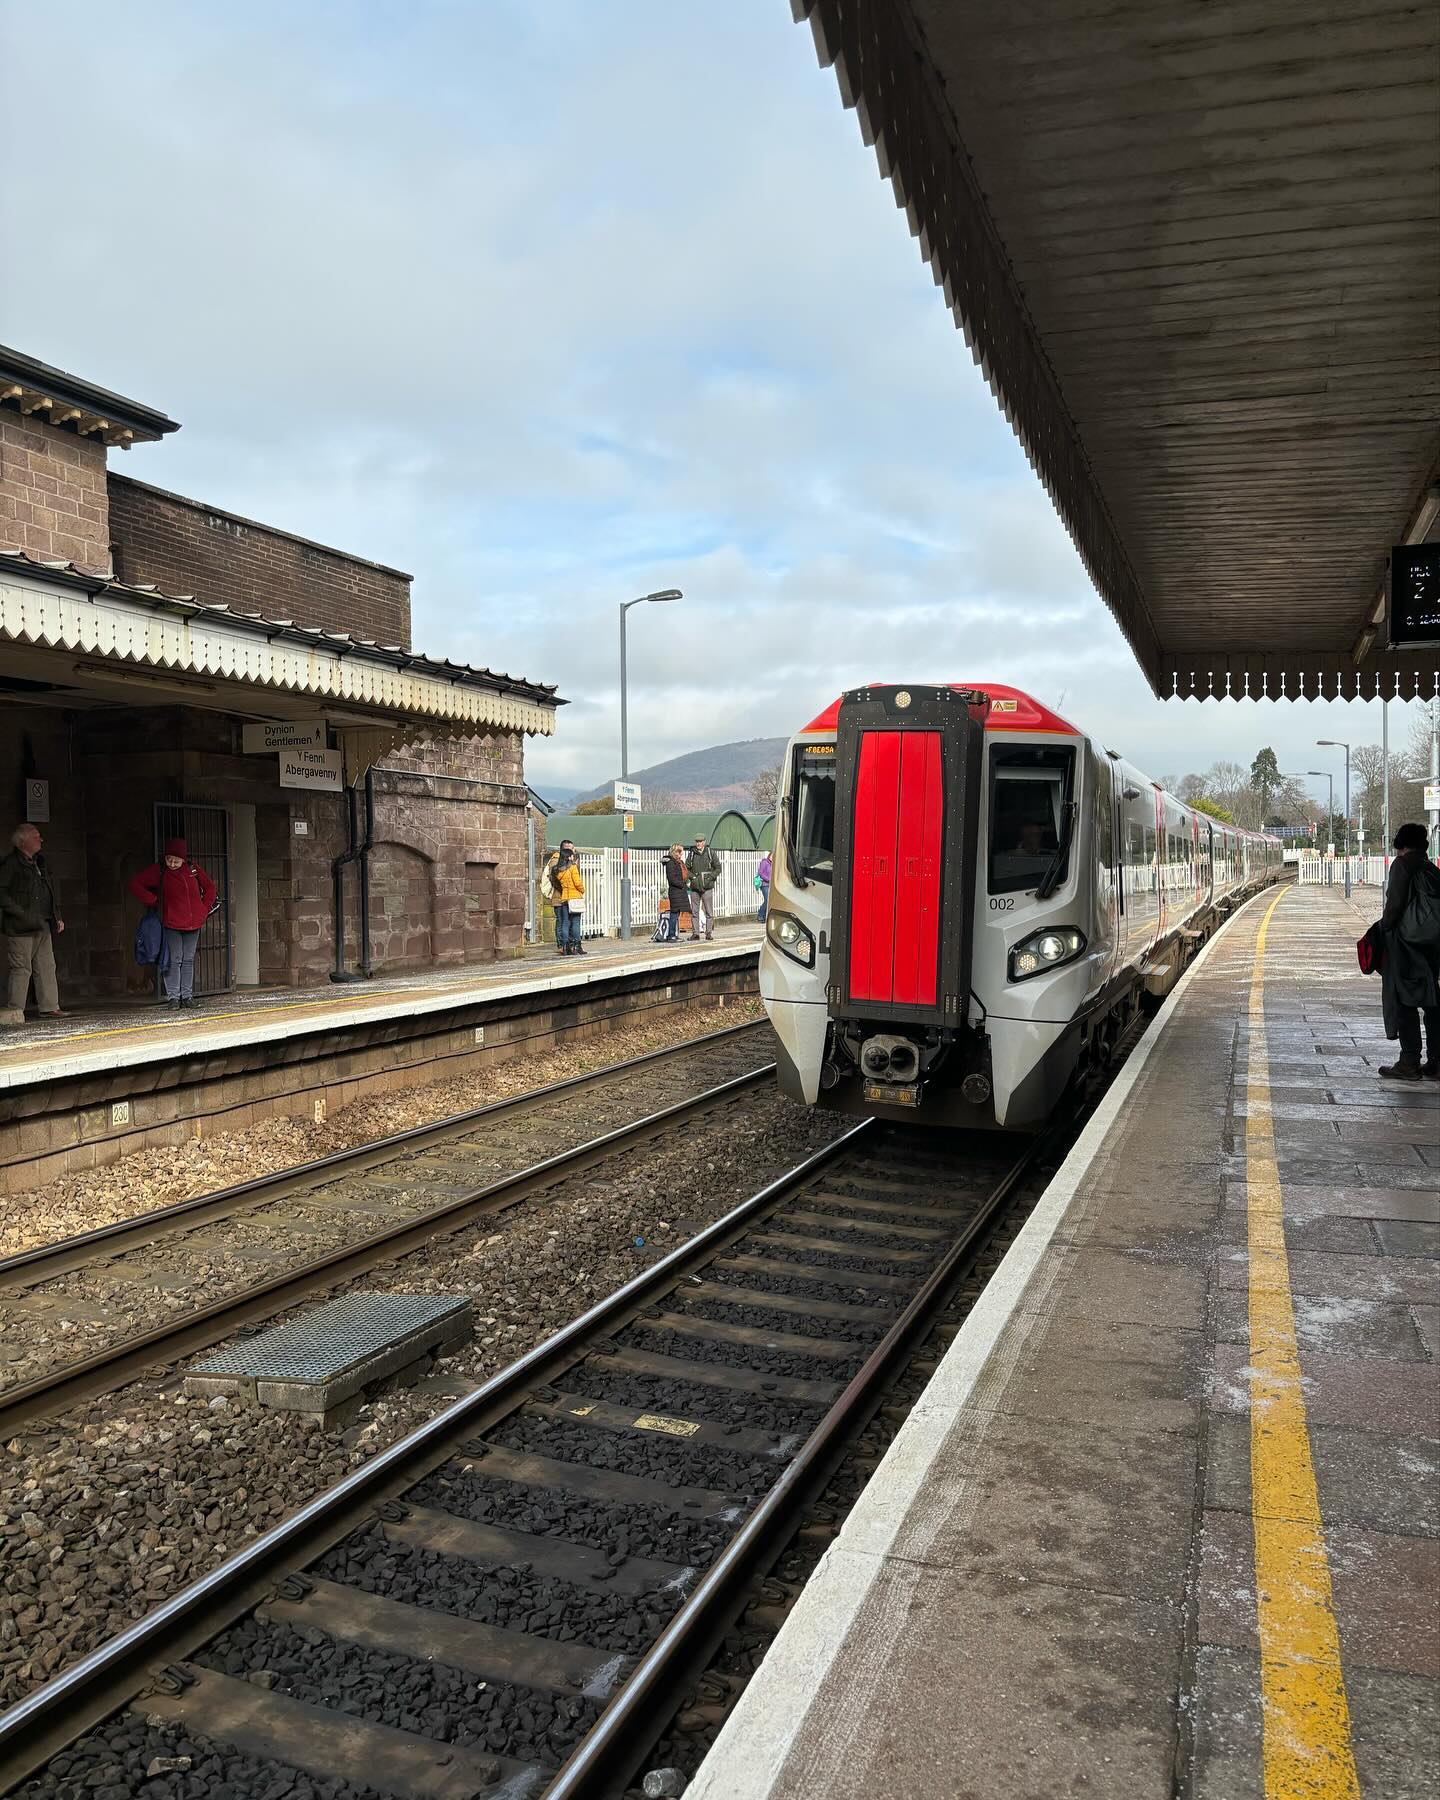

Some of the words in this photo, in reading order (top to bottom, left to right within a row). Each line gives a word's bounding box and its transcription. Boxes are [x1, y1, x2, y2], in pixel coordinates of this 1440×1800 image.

[264, 725, 295, 737] Dynion
[265, 737, 312, 747] Gentlemen
[297, 751, 303, 761] Y
[304, 752, 326, 764] Fenni
[285, 764, 337, 780] Abergavenny
[990, 898, 1015, 910] 002
[114, 1105, 128, 1122] 230
